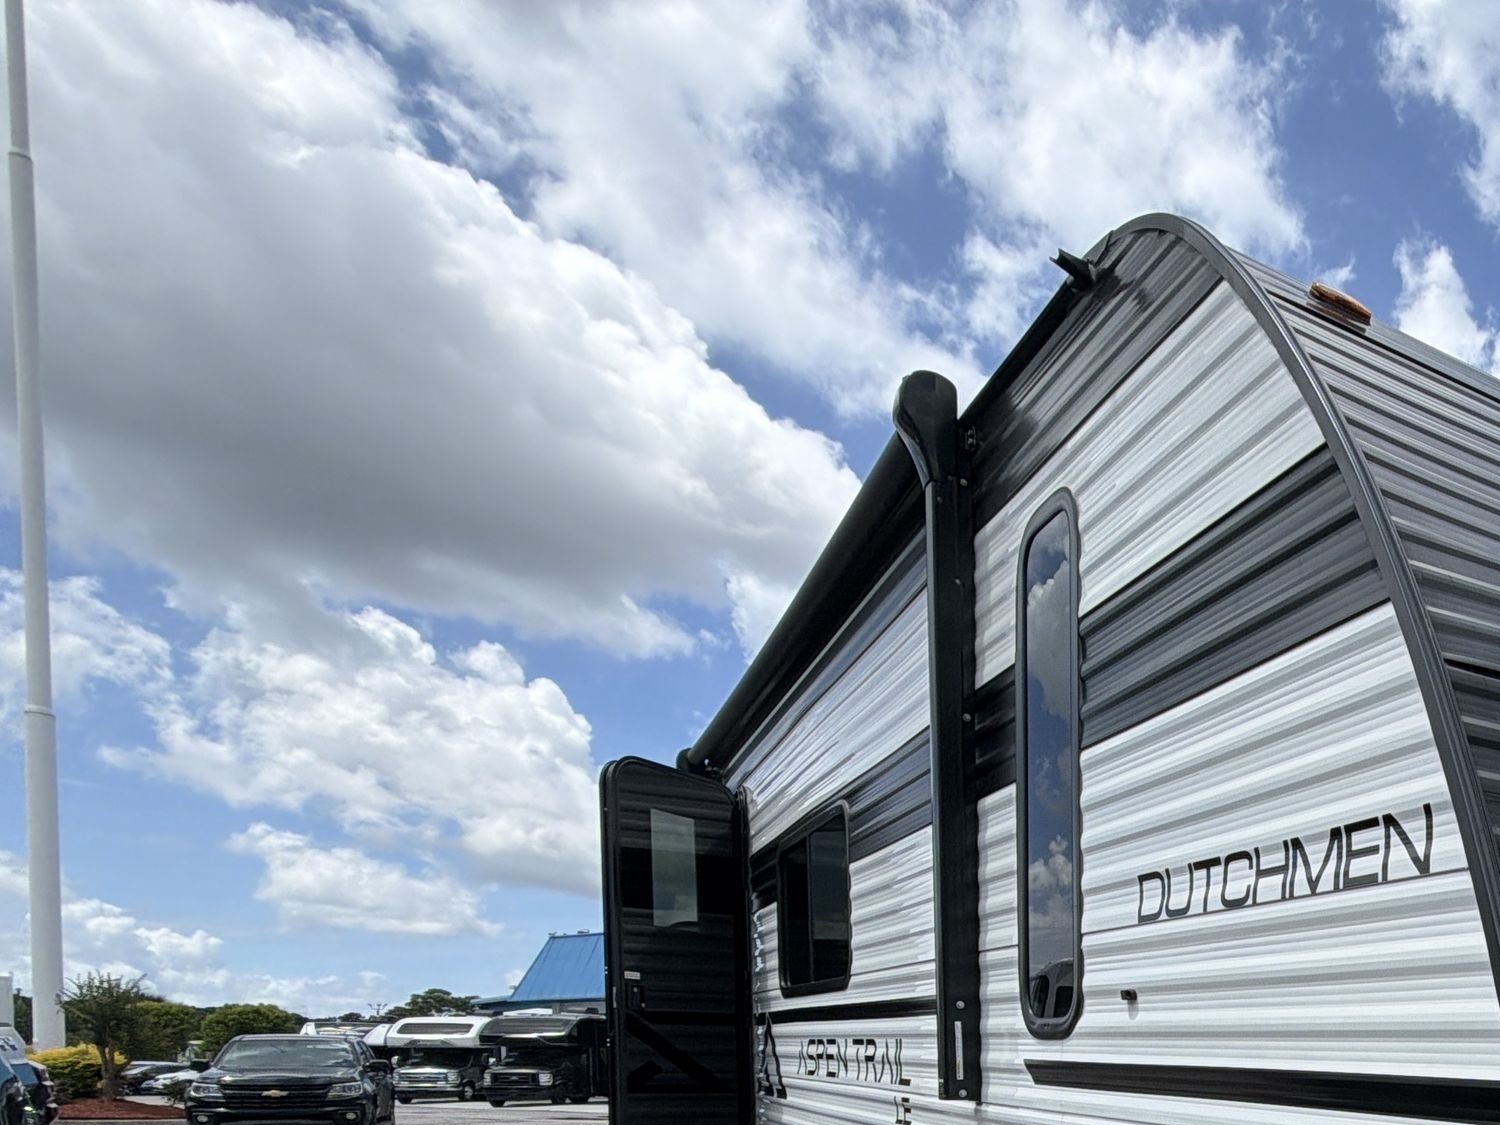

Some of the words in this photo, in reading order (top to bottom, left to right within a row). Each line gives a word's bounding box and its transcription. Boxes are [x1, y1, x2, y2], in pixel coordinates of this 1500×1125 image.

[1138, 803, 1433, 924] DUTCHMEN
[797, 1038, 848, 1078] ASPEN
[852, 1038, 912, 1086] TRAIL
[893, 1096, 912, 1125] LE
